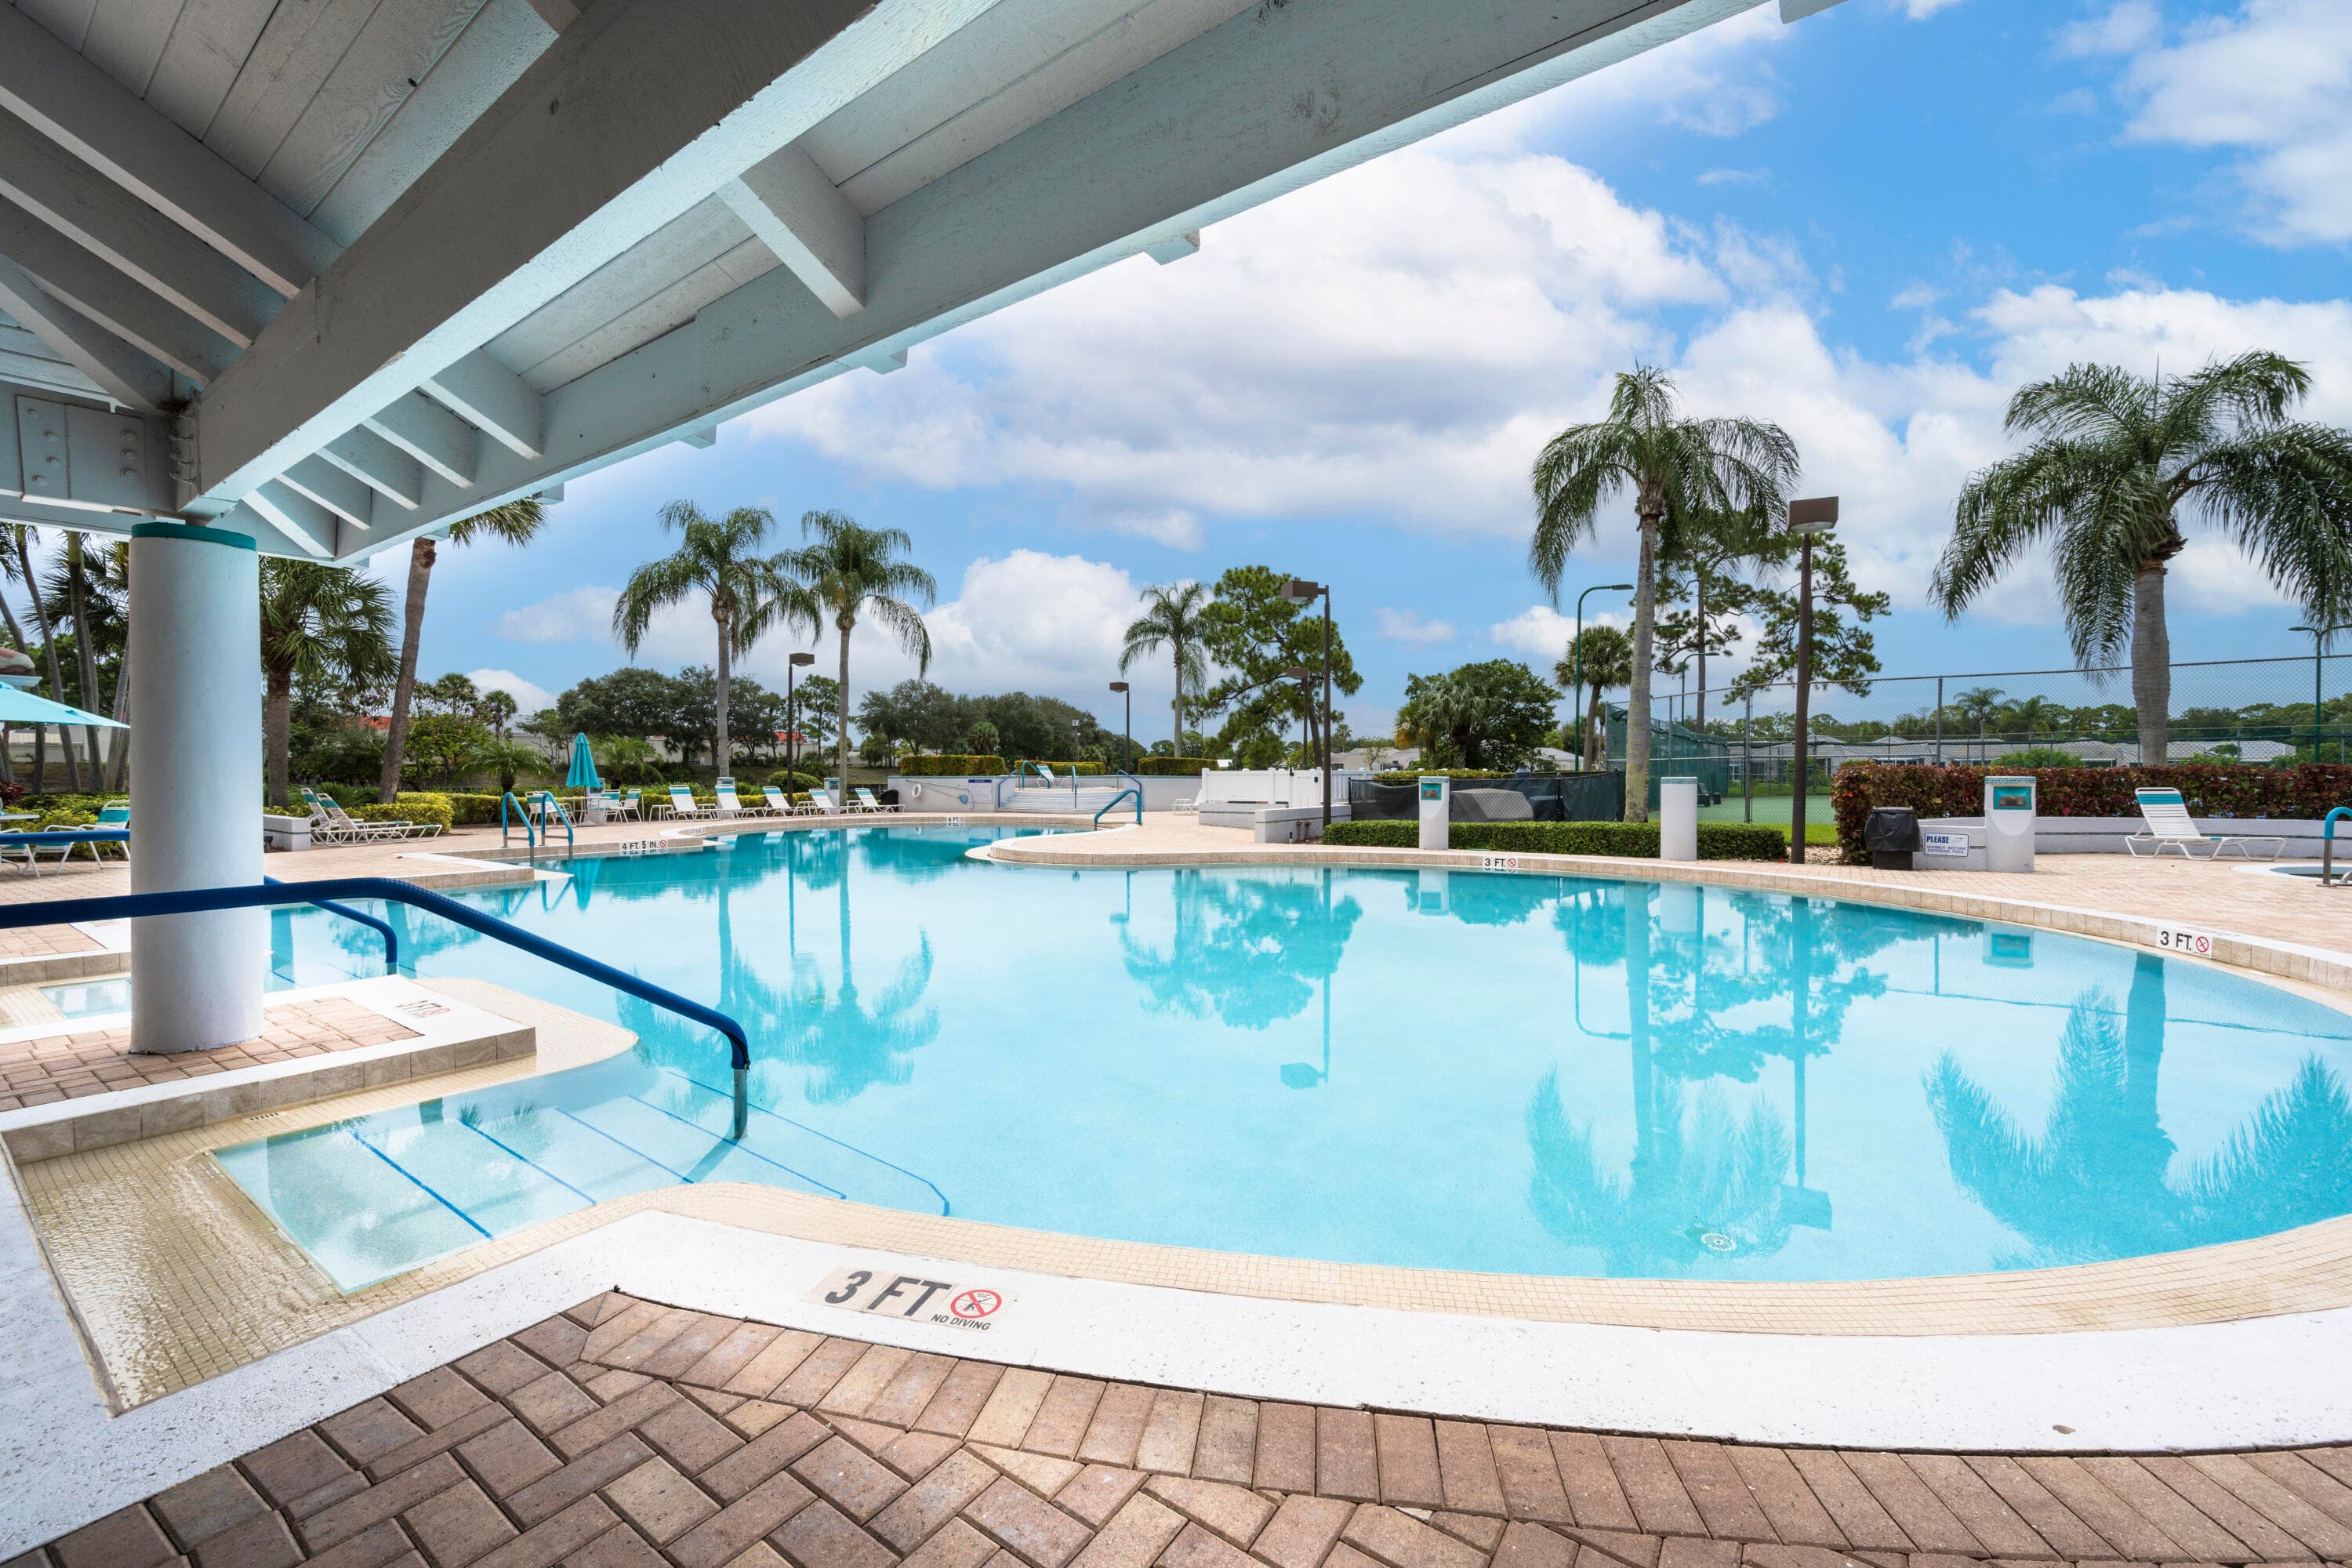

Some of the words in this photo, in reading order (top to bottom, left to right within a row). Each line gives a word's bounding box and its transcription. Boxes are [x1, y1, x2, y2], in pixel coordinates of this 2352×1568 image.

[642, 840, 646, 849] 5
[1926, 835, 1950, 844] PLEASE
[1485, 858, 1490, 866] 3
[2160, 931, 2169, 946] 3
[2176, 932, 2193, 951] FT.
[825, 1270, 873, 1304] 3
[866, 1276, 953, 1317] FT
[931, 1314, 949, 1323] NO
[949, 1317, 992, 1330] DIVING
